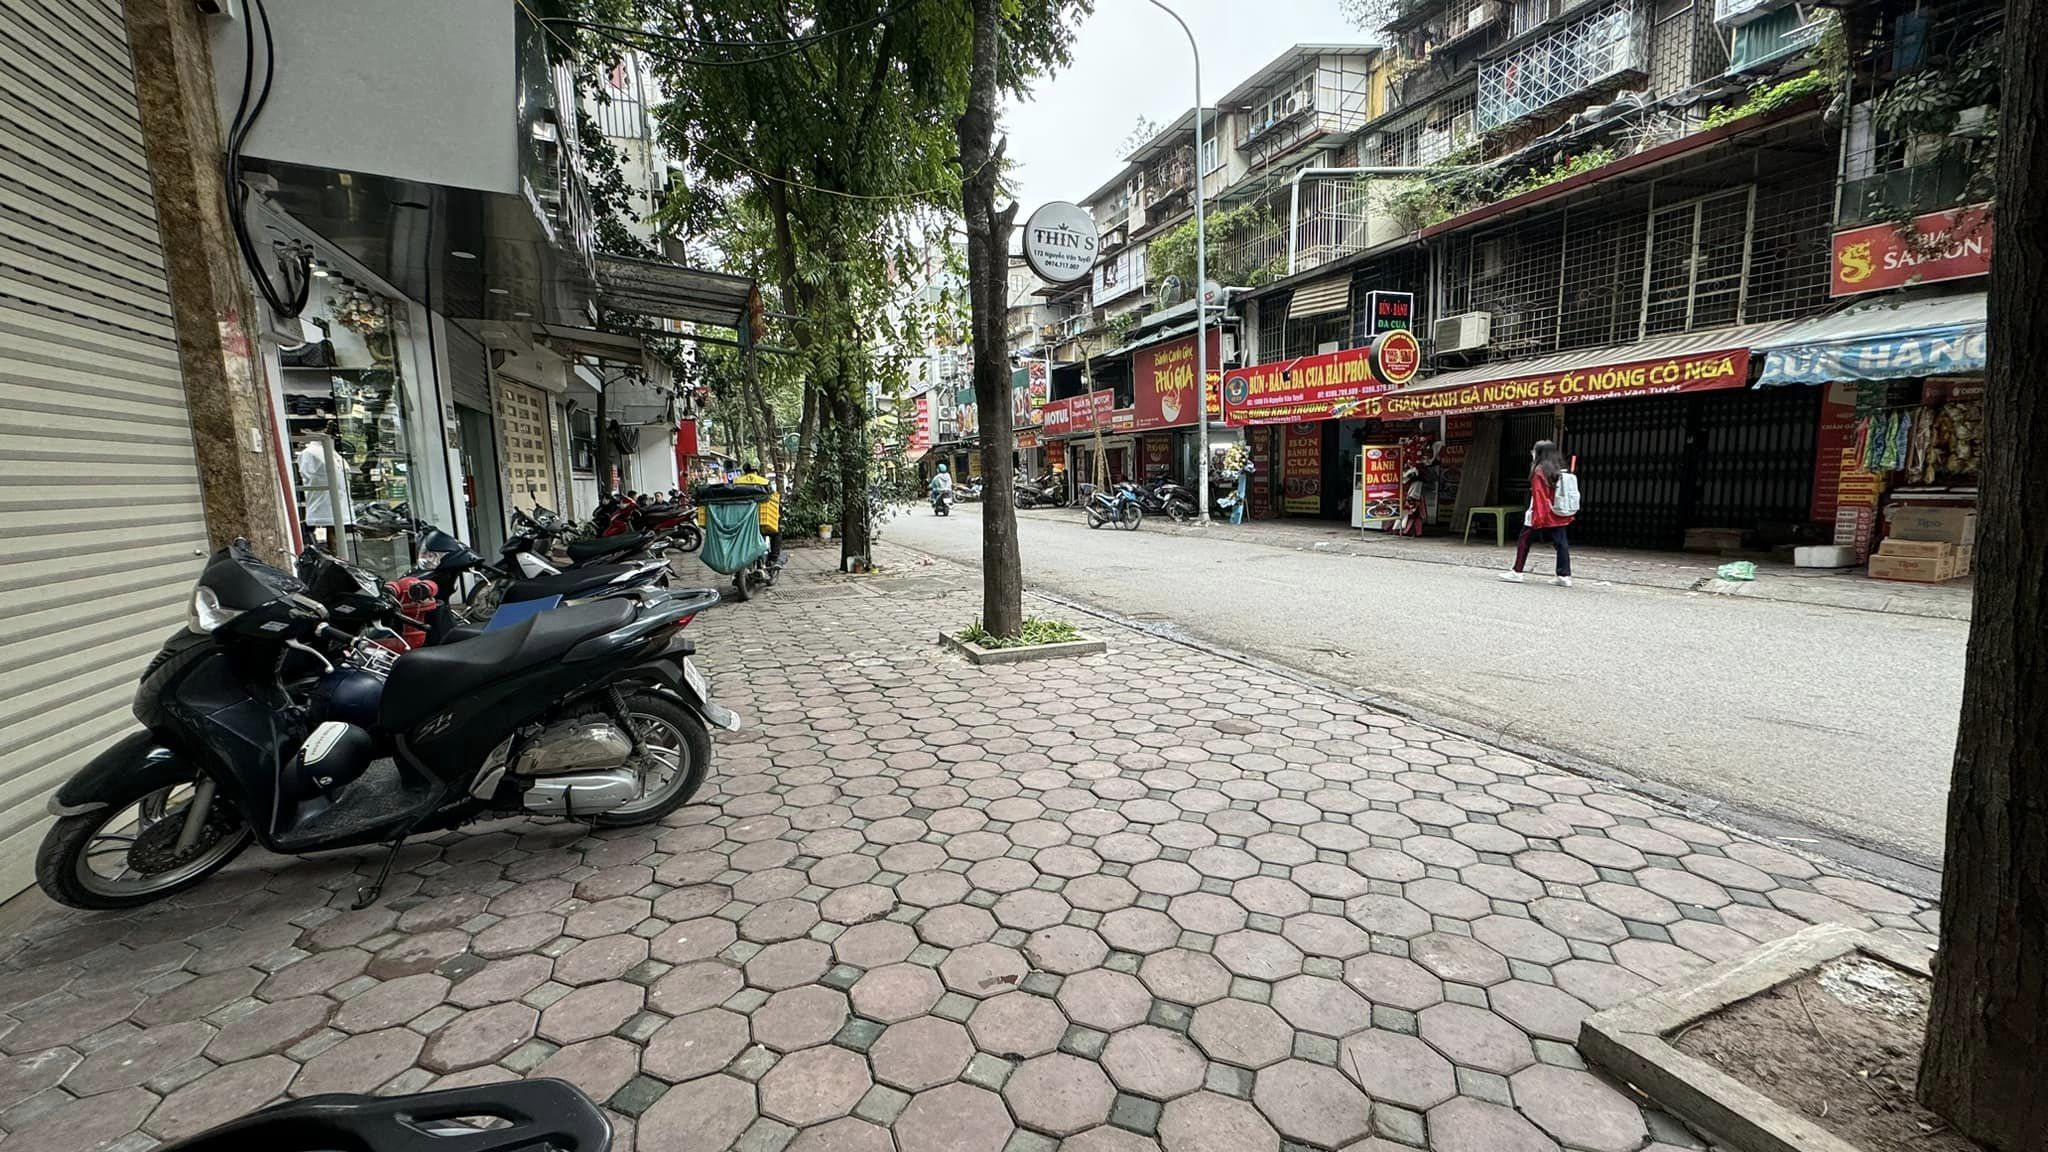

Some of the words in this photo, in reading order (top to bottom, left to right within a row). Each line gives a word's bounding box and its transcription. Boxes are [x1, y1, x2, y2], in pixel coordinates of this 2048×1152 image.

[1084, 236, 1094, 251] S
[1390, 320, 1406, 328] CUA
[1154, 364, 1174, 393] PHÚ
[1249, 370, 1264, 394] BÚN
[1292, 368, 1304, 389] ĐA
[1305, 366, 1324, 388] CUA
[1326, 354, 1343, 385] HẢI
[1344, 353, 1376, 384] PHÒN
[1388, 395, 1420, 412] CHÂN
[1461, 386, 1480, 404] GÀ
[1543, 380, 1556, 396] &
[1559, 370, 1585, 394] ỐC
[1588, 368, 1645, 392] NÓNG
[1649, 361, 1680, 384] CÔ
[1684, 357, 1735, 380] NGA
[1044, 408, 1069, 426] MOTUL
[1288, 437, 1318, 448] BÚN
[1287, 458, 1318, 466] CUA
[1370, 459, 1395, 471] BÁNH
[1366, 474, 1380, 484] ĐA
[1381, 473, 1398, 483] CUA
